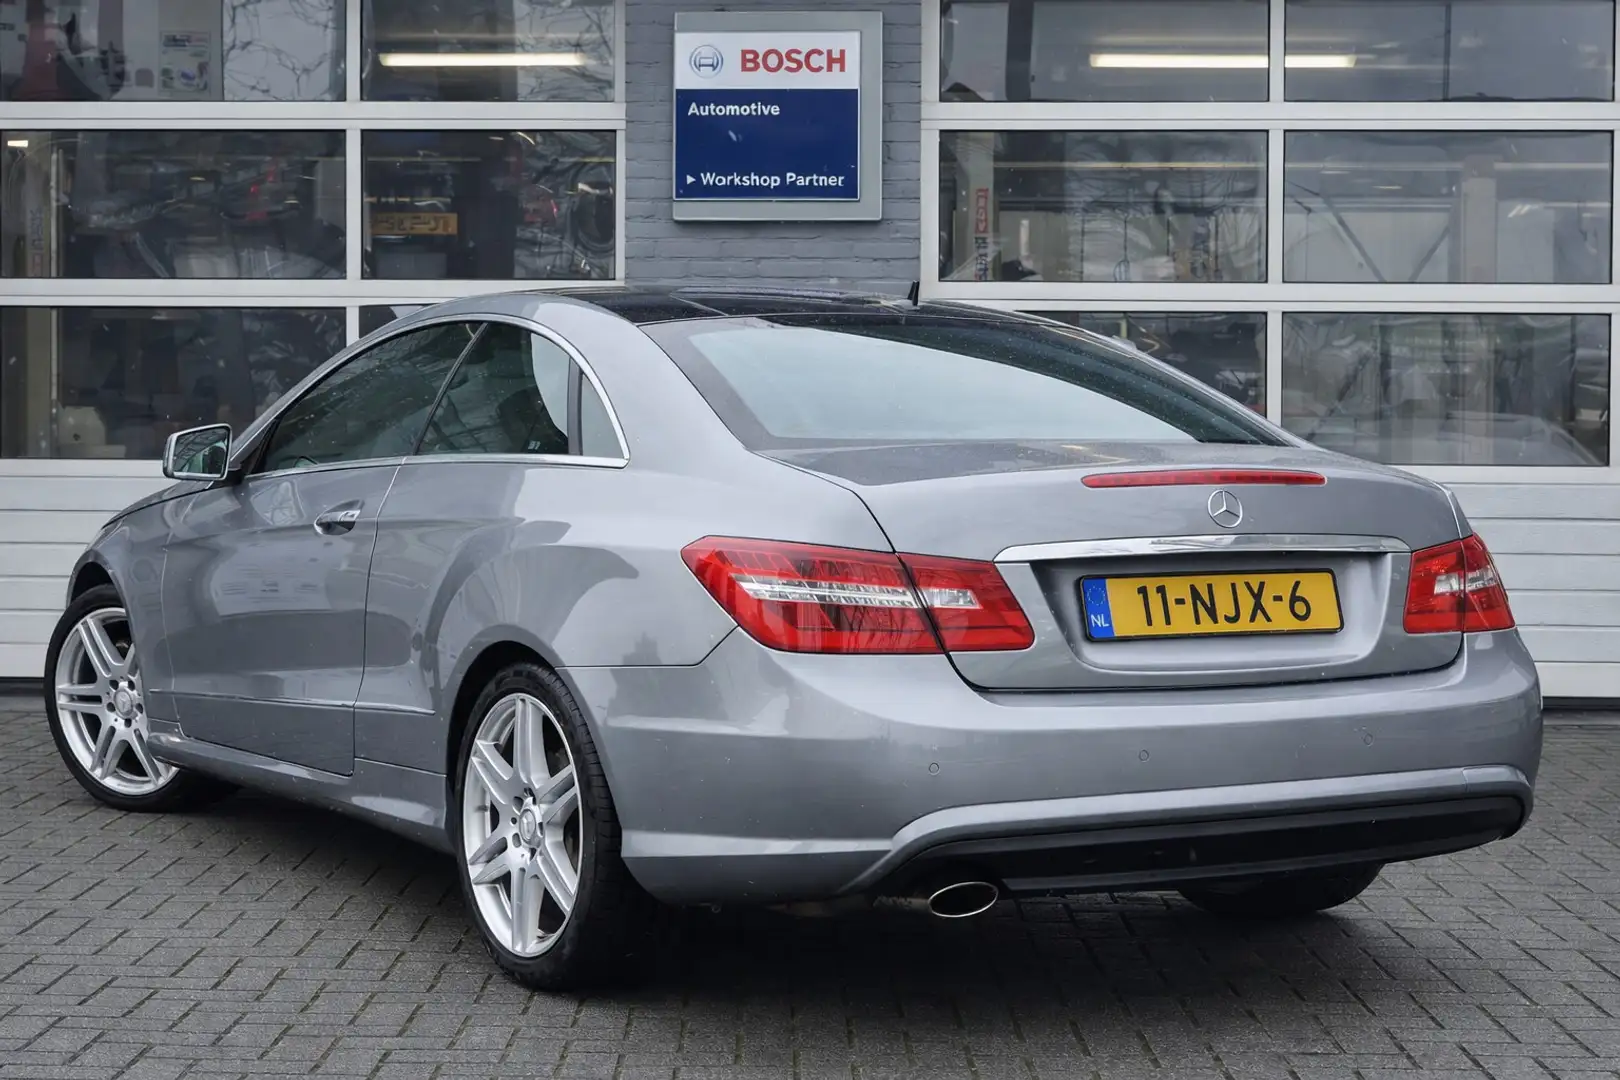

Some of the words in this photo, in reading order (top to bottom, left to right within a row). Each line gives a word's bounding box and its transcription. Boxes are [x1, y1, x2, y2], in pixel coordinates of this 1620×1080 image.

[740, 48, 846, 73] BOSCH
[687, 102, 780, 116] Automotive
[700, 172, 781, 189] Workshop
[785, 172, 845, 187] Partner
[1136, 580, 1312, 627] 11-NJX-6
[1090, 613, 1110, 628] NL
